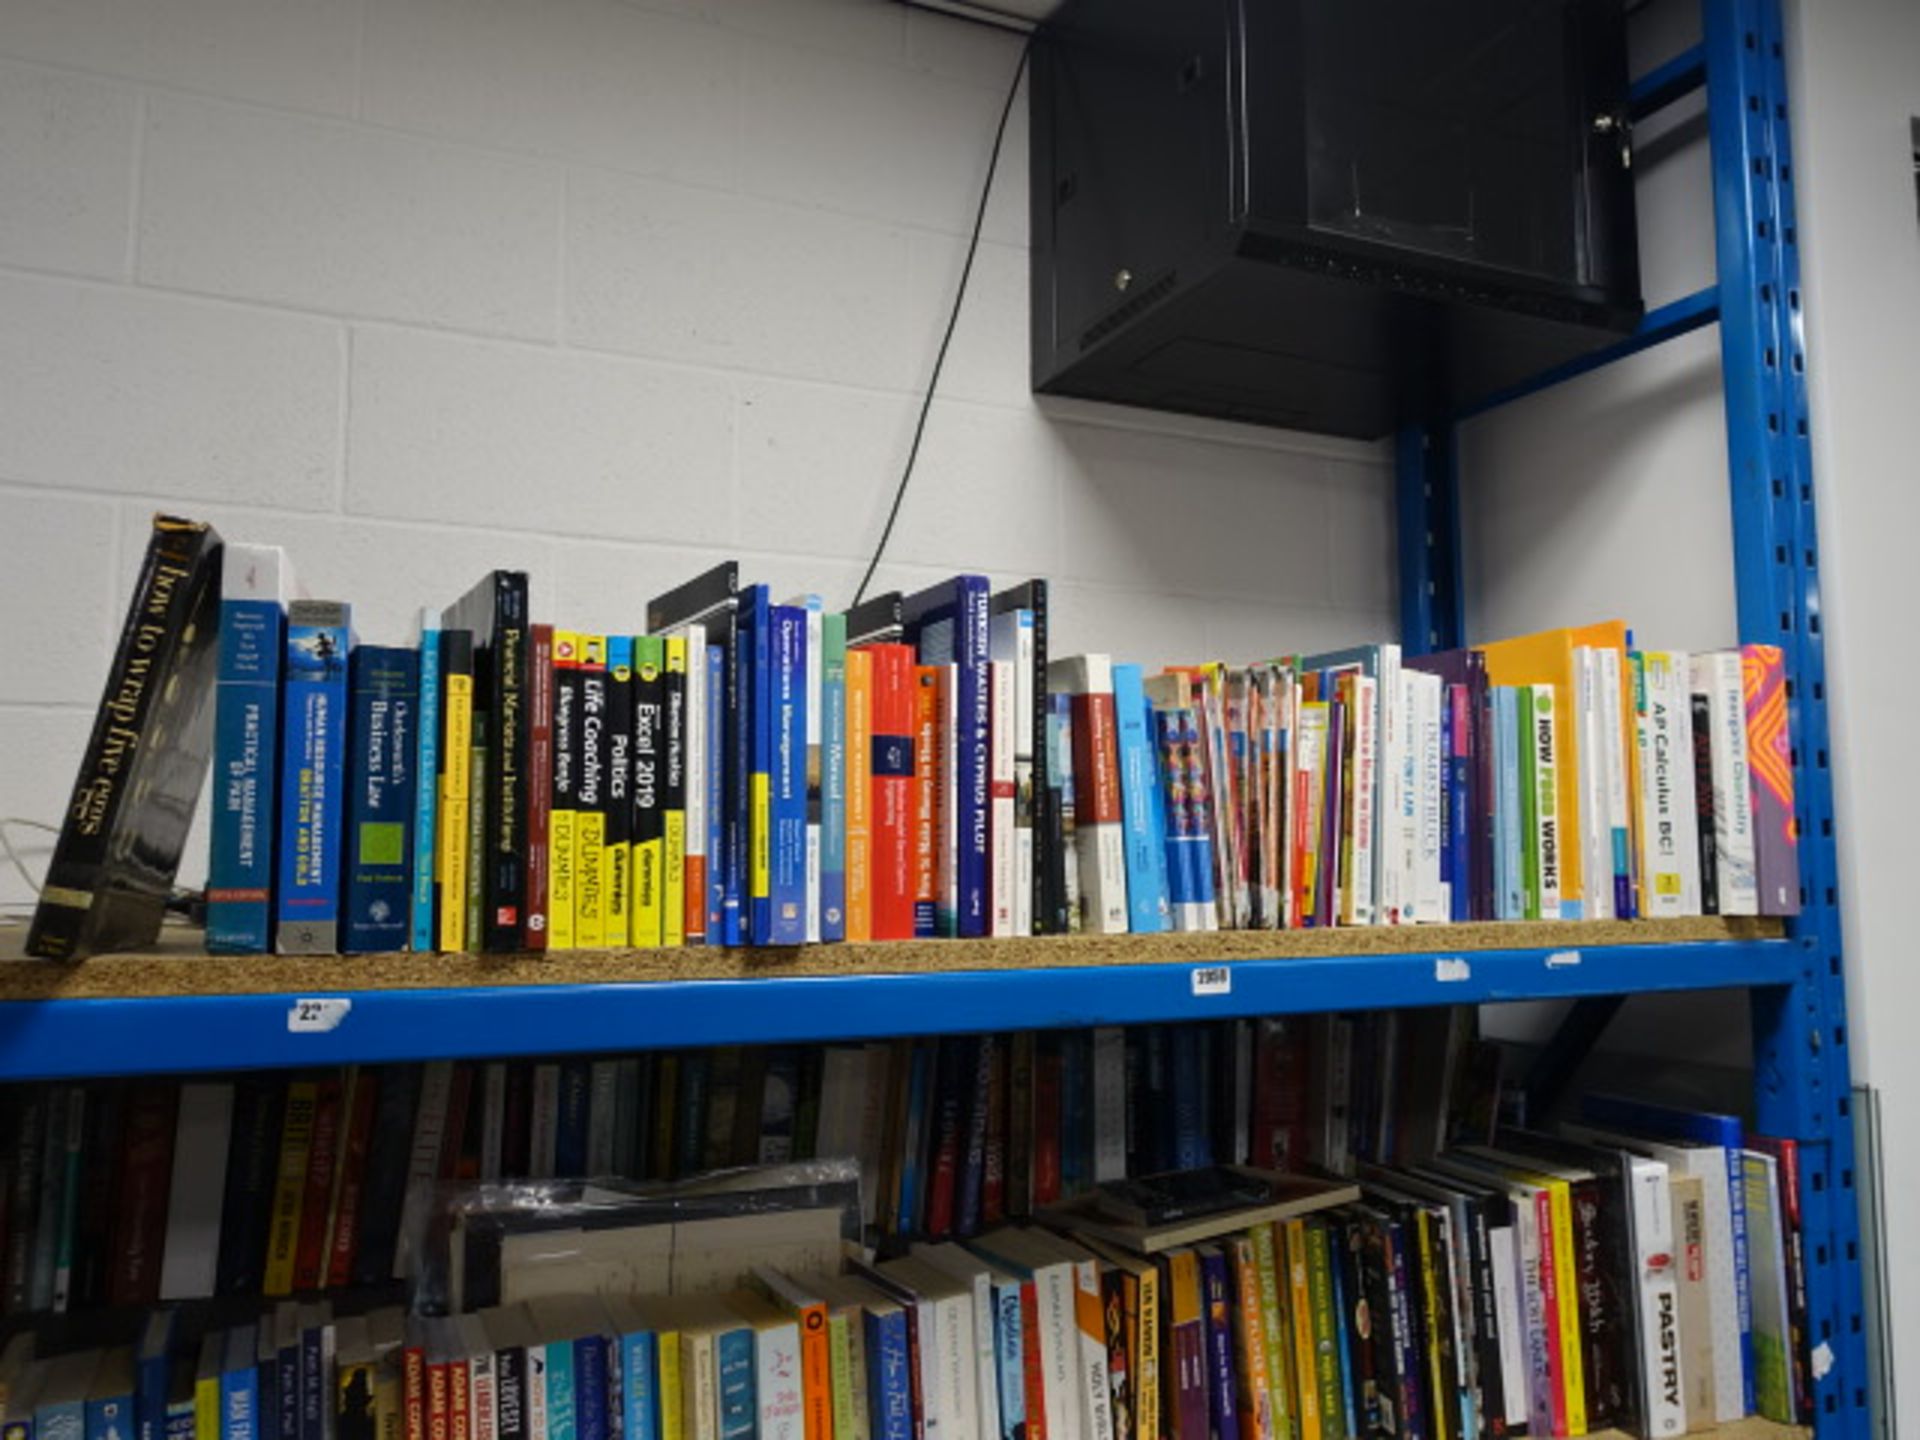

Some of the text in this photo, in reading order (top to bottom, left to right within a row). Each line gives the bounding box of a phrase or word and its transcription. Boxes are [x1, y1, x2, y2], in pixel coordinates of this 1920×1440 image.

[503, 628, 519, 688] Financial
[74, 565, 188, 834] how to wrap five eggs
[503, 692, 518, 749] Markets
[778, 620, 793, 798] Operations Management
[974, 591, 989, 853] TURKISH WATERS & CYPRUS PILOT
[1653, 703, 1668, 730] AP
[367, 701, 388, 808] Business Law
[557, 752, 572, 791] Banjo
[579, 679, 601, 804] Life Coaching
[611, 734, 628, 798] Politics
[637, 703, 655, 807] Excel 2019
[1538, 719, 1552, 762] HOW
[1655, 734, 1674, 814] Calculus
[239, 704, 259, 867] PRACTICAL MANAGEMENT
[311, 693, 327, 885] HUMAN RESOURCE MANAGEMENT
[1732, 761, 1748, 836] Chemistry
[582, 829, 602, 918] DUMMIES
[1543, 820, 1558, 889] WORKS
[407, 1352, 420, 1399] ADAM
[1658, 1292, 1679, 1406] PASTRY
[431, 1370, 445, 1413] ADAM
[452, 1367, 465, 1411] ADAM
